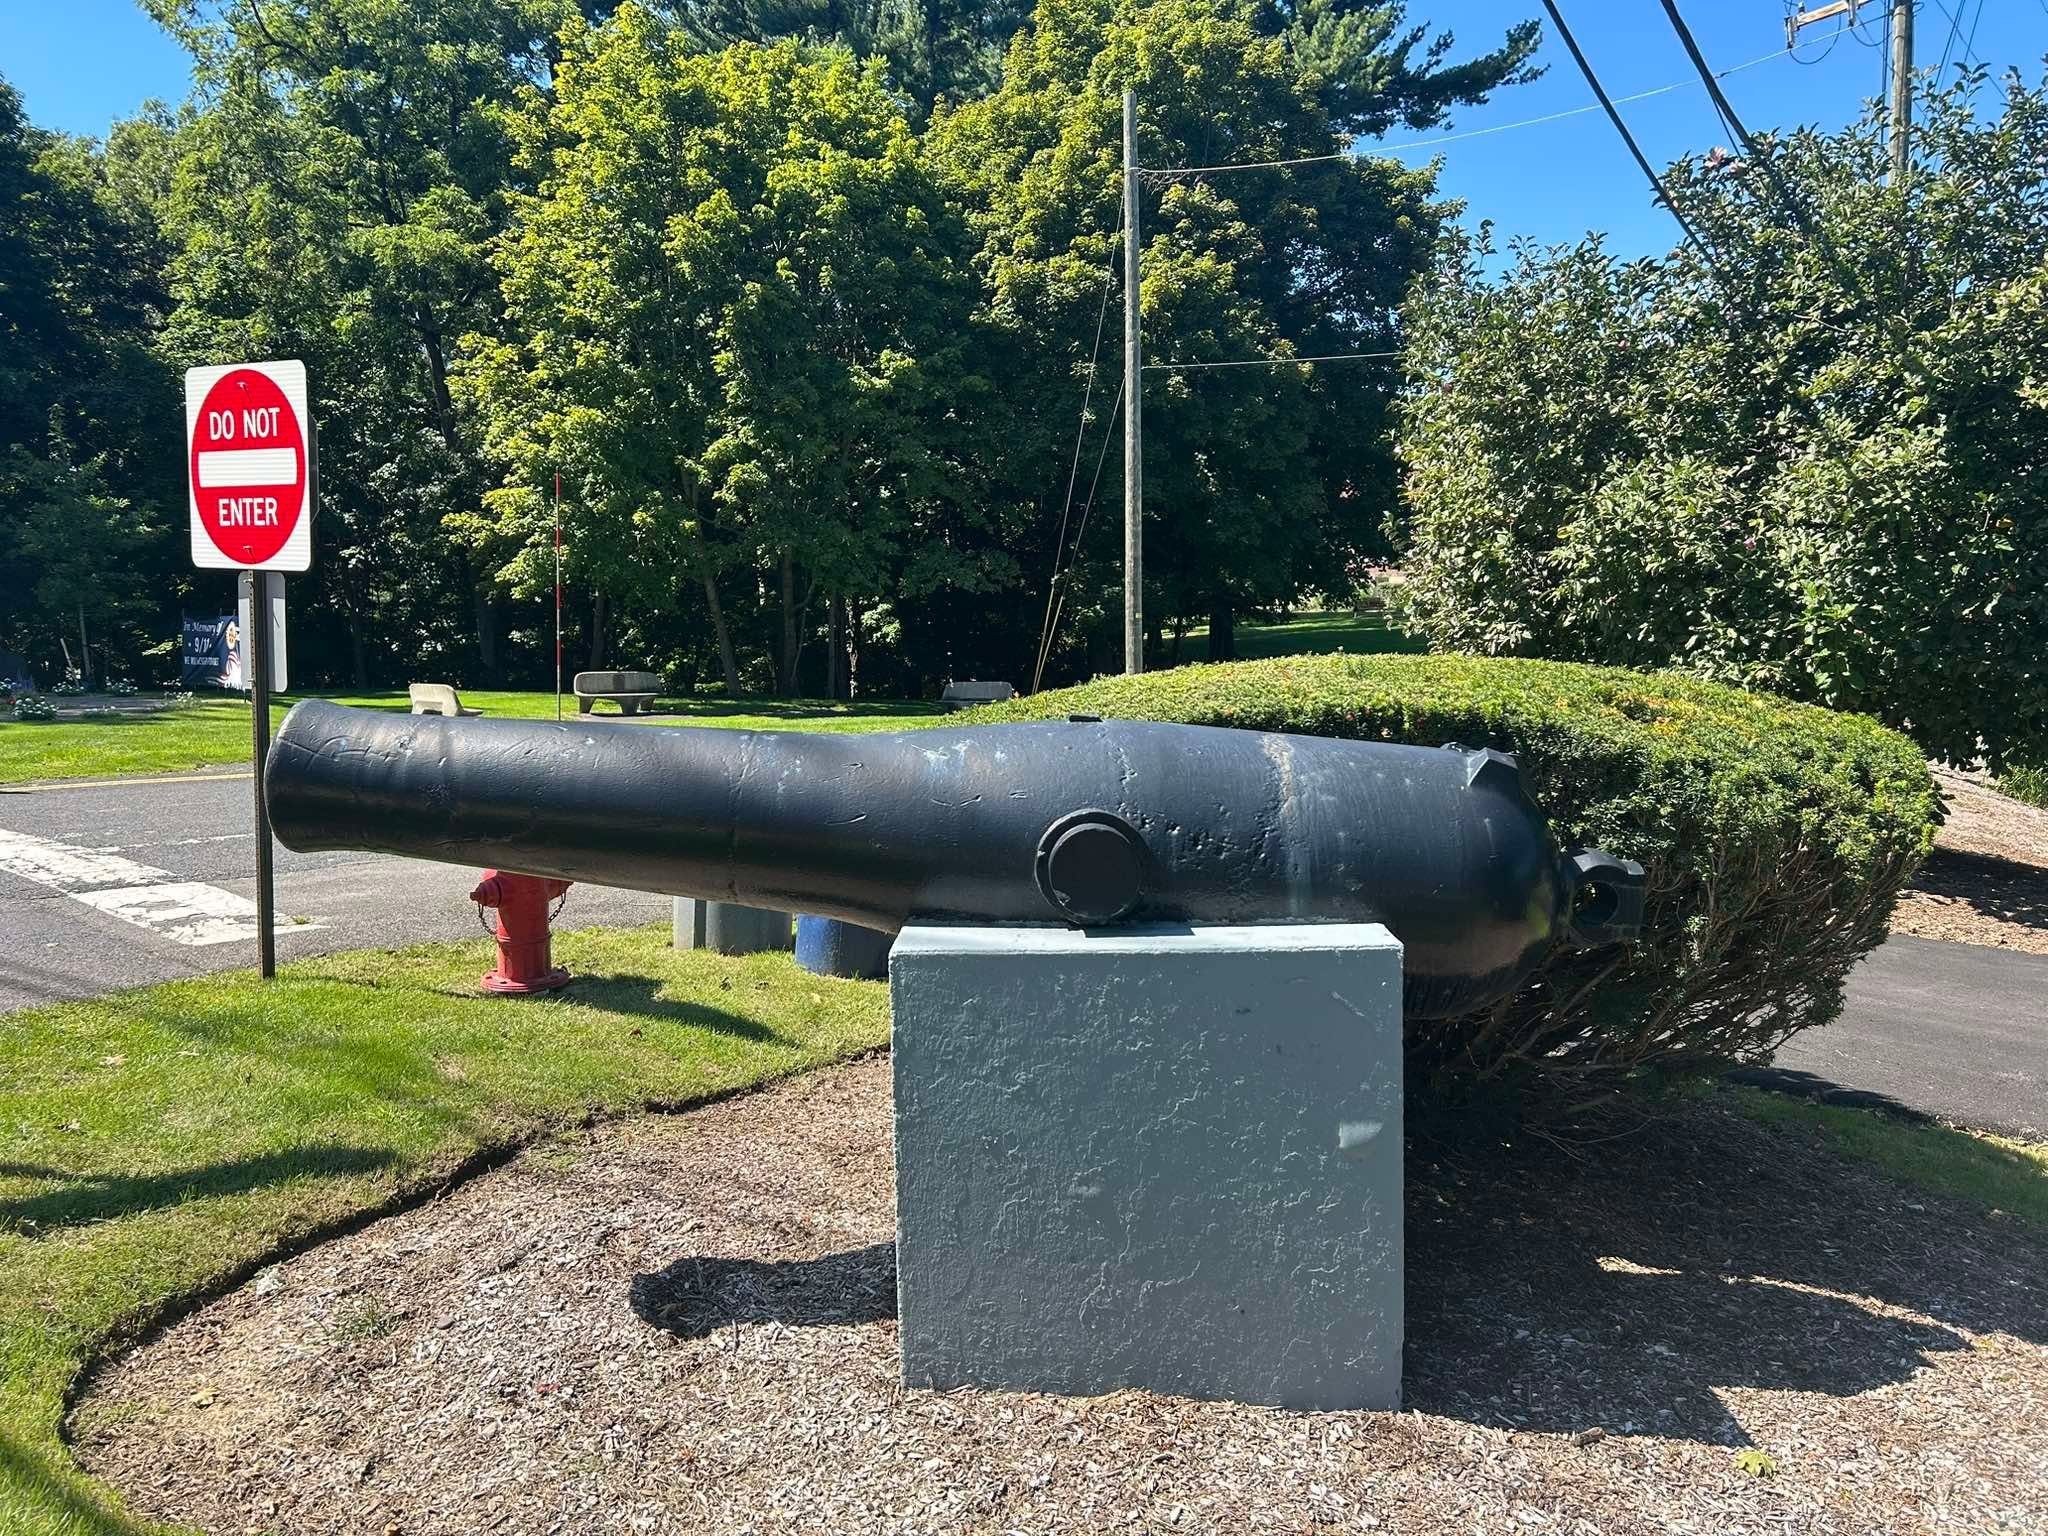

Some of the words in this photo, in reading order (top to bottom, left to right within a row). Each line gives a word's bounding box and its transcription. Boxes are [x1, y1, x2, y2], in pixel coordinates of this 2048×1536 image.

[209, 410, 235, 440] DO
[243, 407, 280, 438] NOT
[218, 497, 278, 527] ENTER
